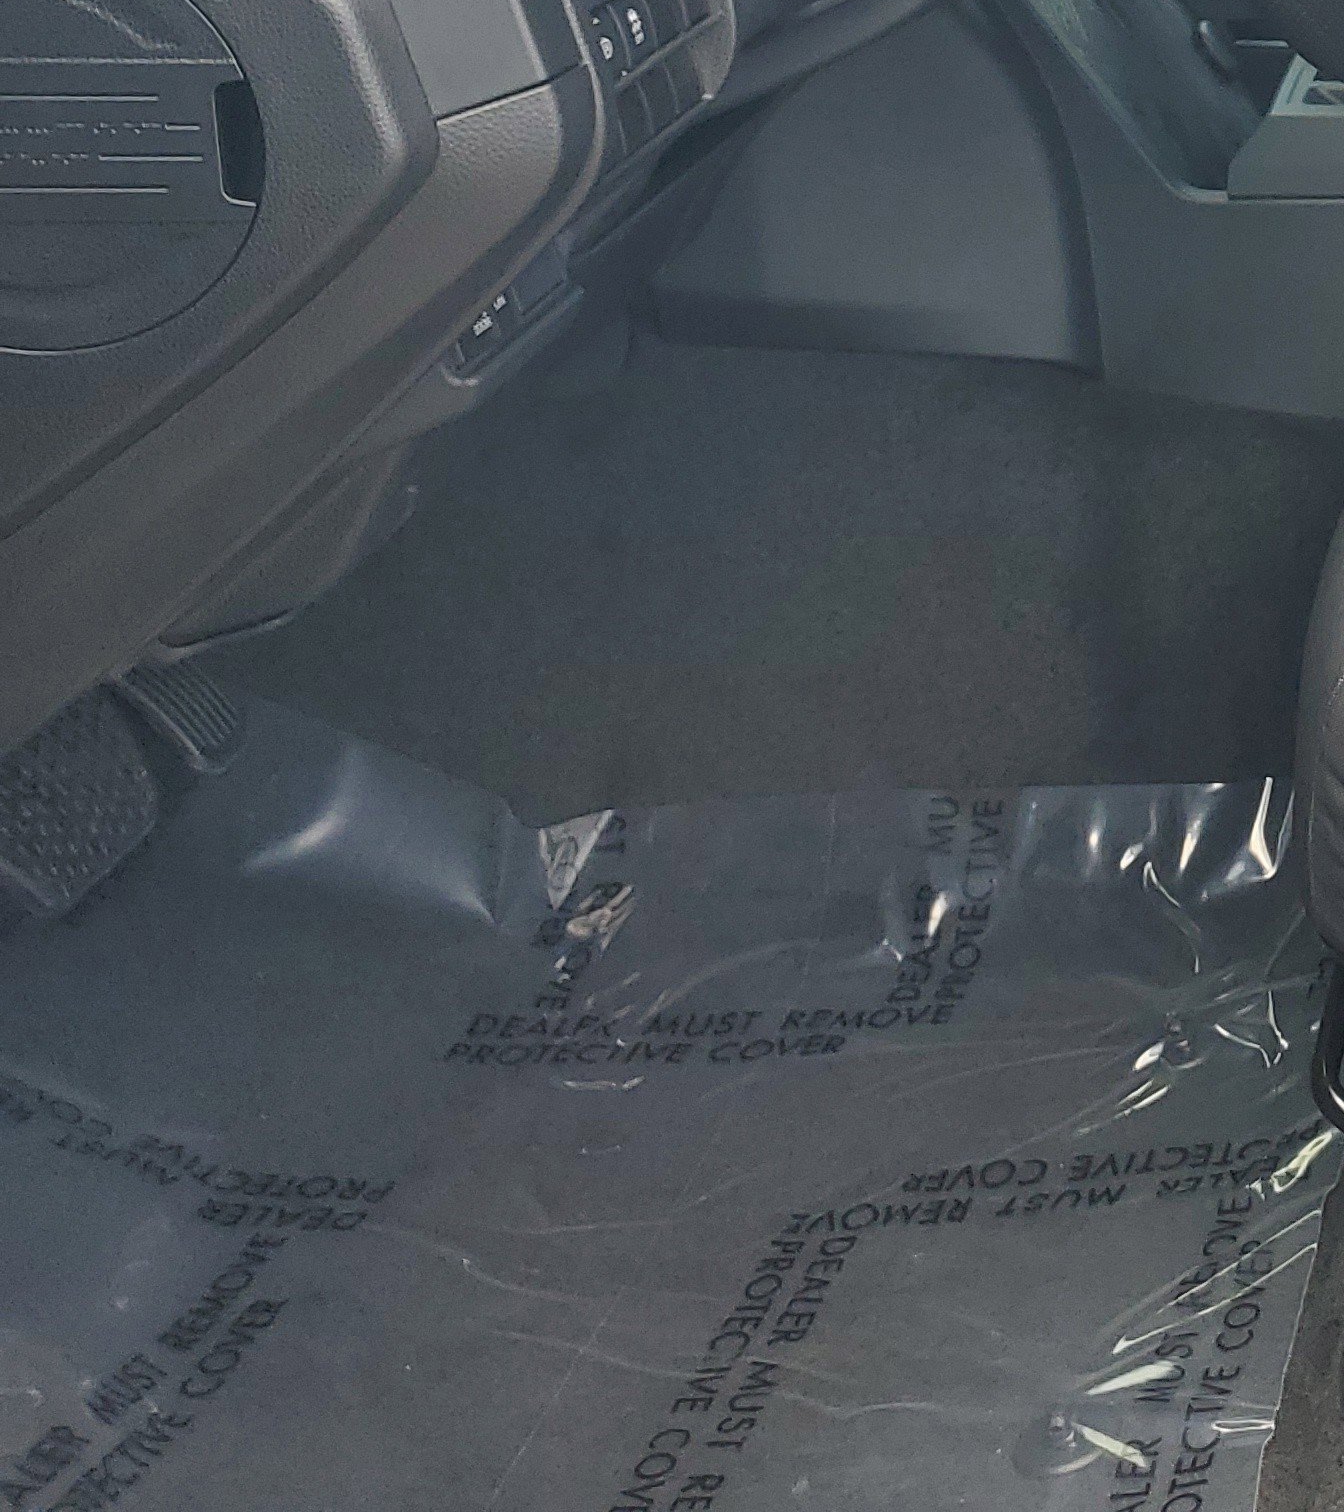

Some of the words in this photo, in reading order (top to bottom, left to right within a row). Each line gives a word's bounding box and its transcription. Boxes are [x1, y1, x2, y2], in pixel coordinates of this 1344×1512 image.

[933, 798, 1004, 1001] PROTECTIVE
[641, 1009, 763, 1038] MUST
[782, 1000, 958, 1031] REMOVE
[442, 1039, 698, 1066] PROTECTIVE
[708, 1032, 847, 1066] COVER
[900, 1157, 1050, 1194] COVER
[996, 1183, 1129, 1219] MUST
[200, 1198, 368, 1233] DEALER
[780, 1195, 973, 1234] REMOVE
[766, 1235, 858, 1348] DEALER
[179, 1298, 291, 1398] COVER
[83, 1352, 169, 1426] MUST
[702, 1360, 781, 1453] MUST
[1160, 1364, 1243, 1512] OTECTIVE
